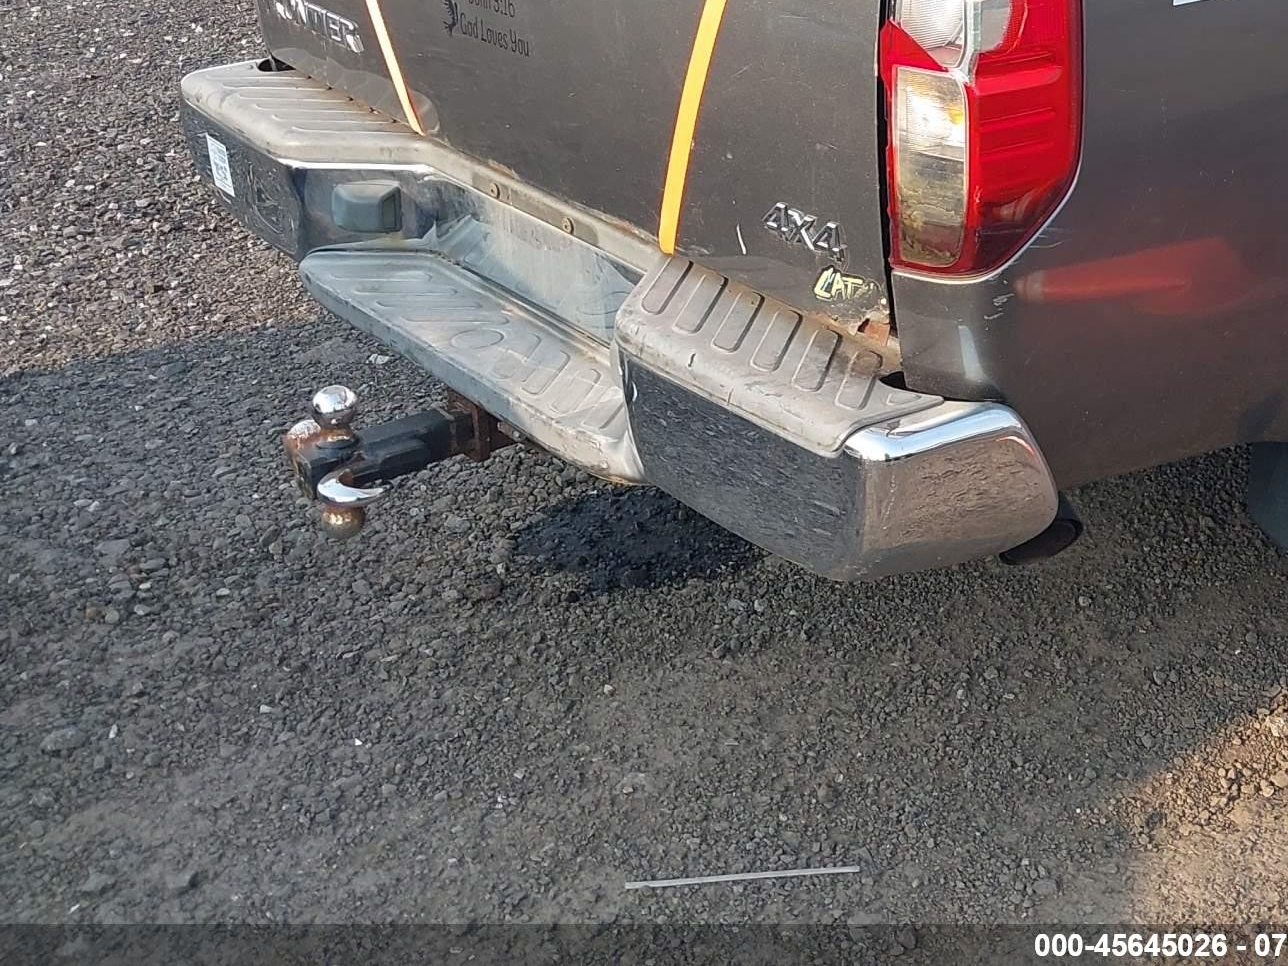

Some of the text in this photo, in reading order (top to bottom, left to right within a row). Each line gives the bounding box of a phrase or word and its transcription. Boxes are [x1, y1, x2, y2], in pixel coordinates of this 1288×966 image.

[460, 12, 531, 58] God Loves You
